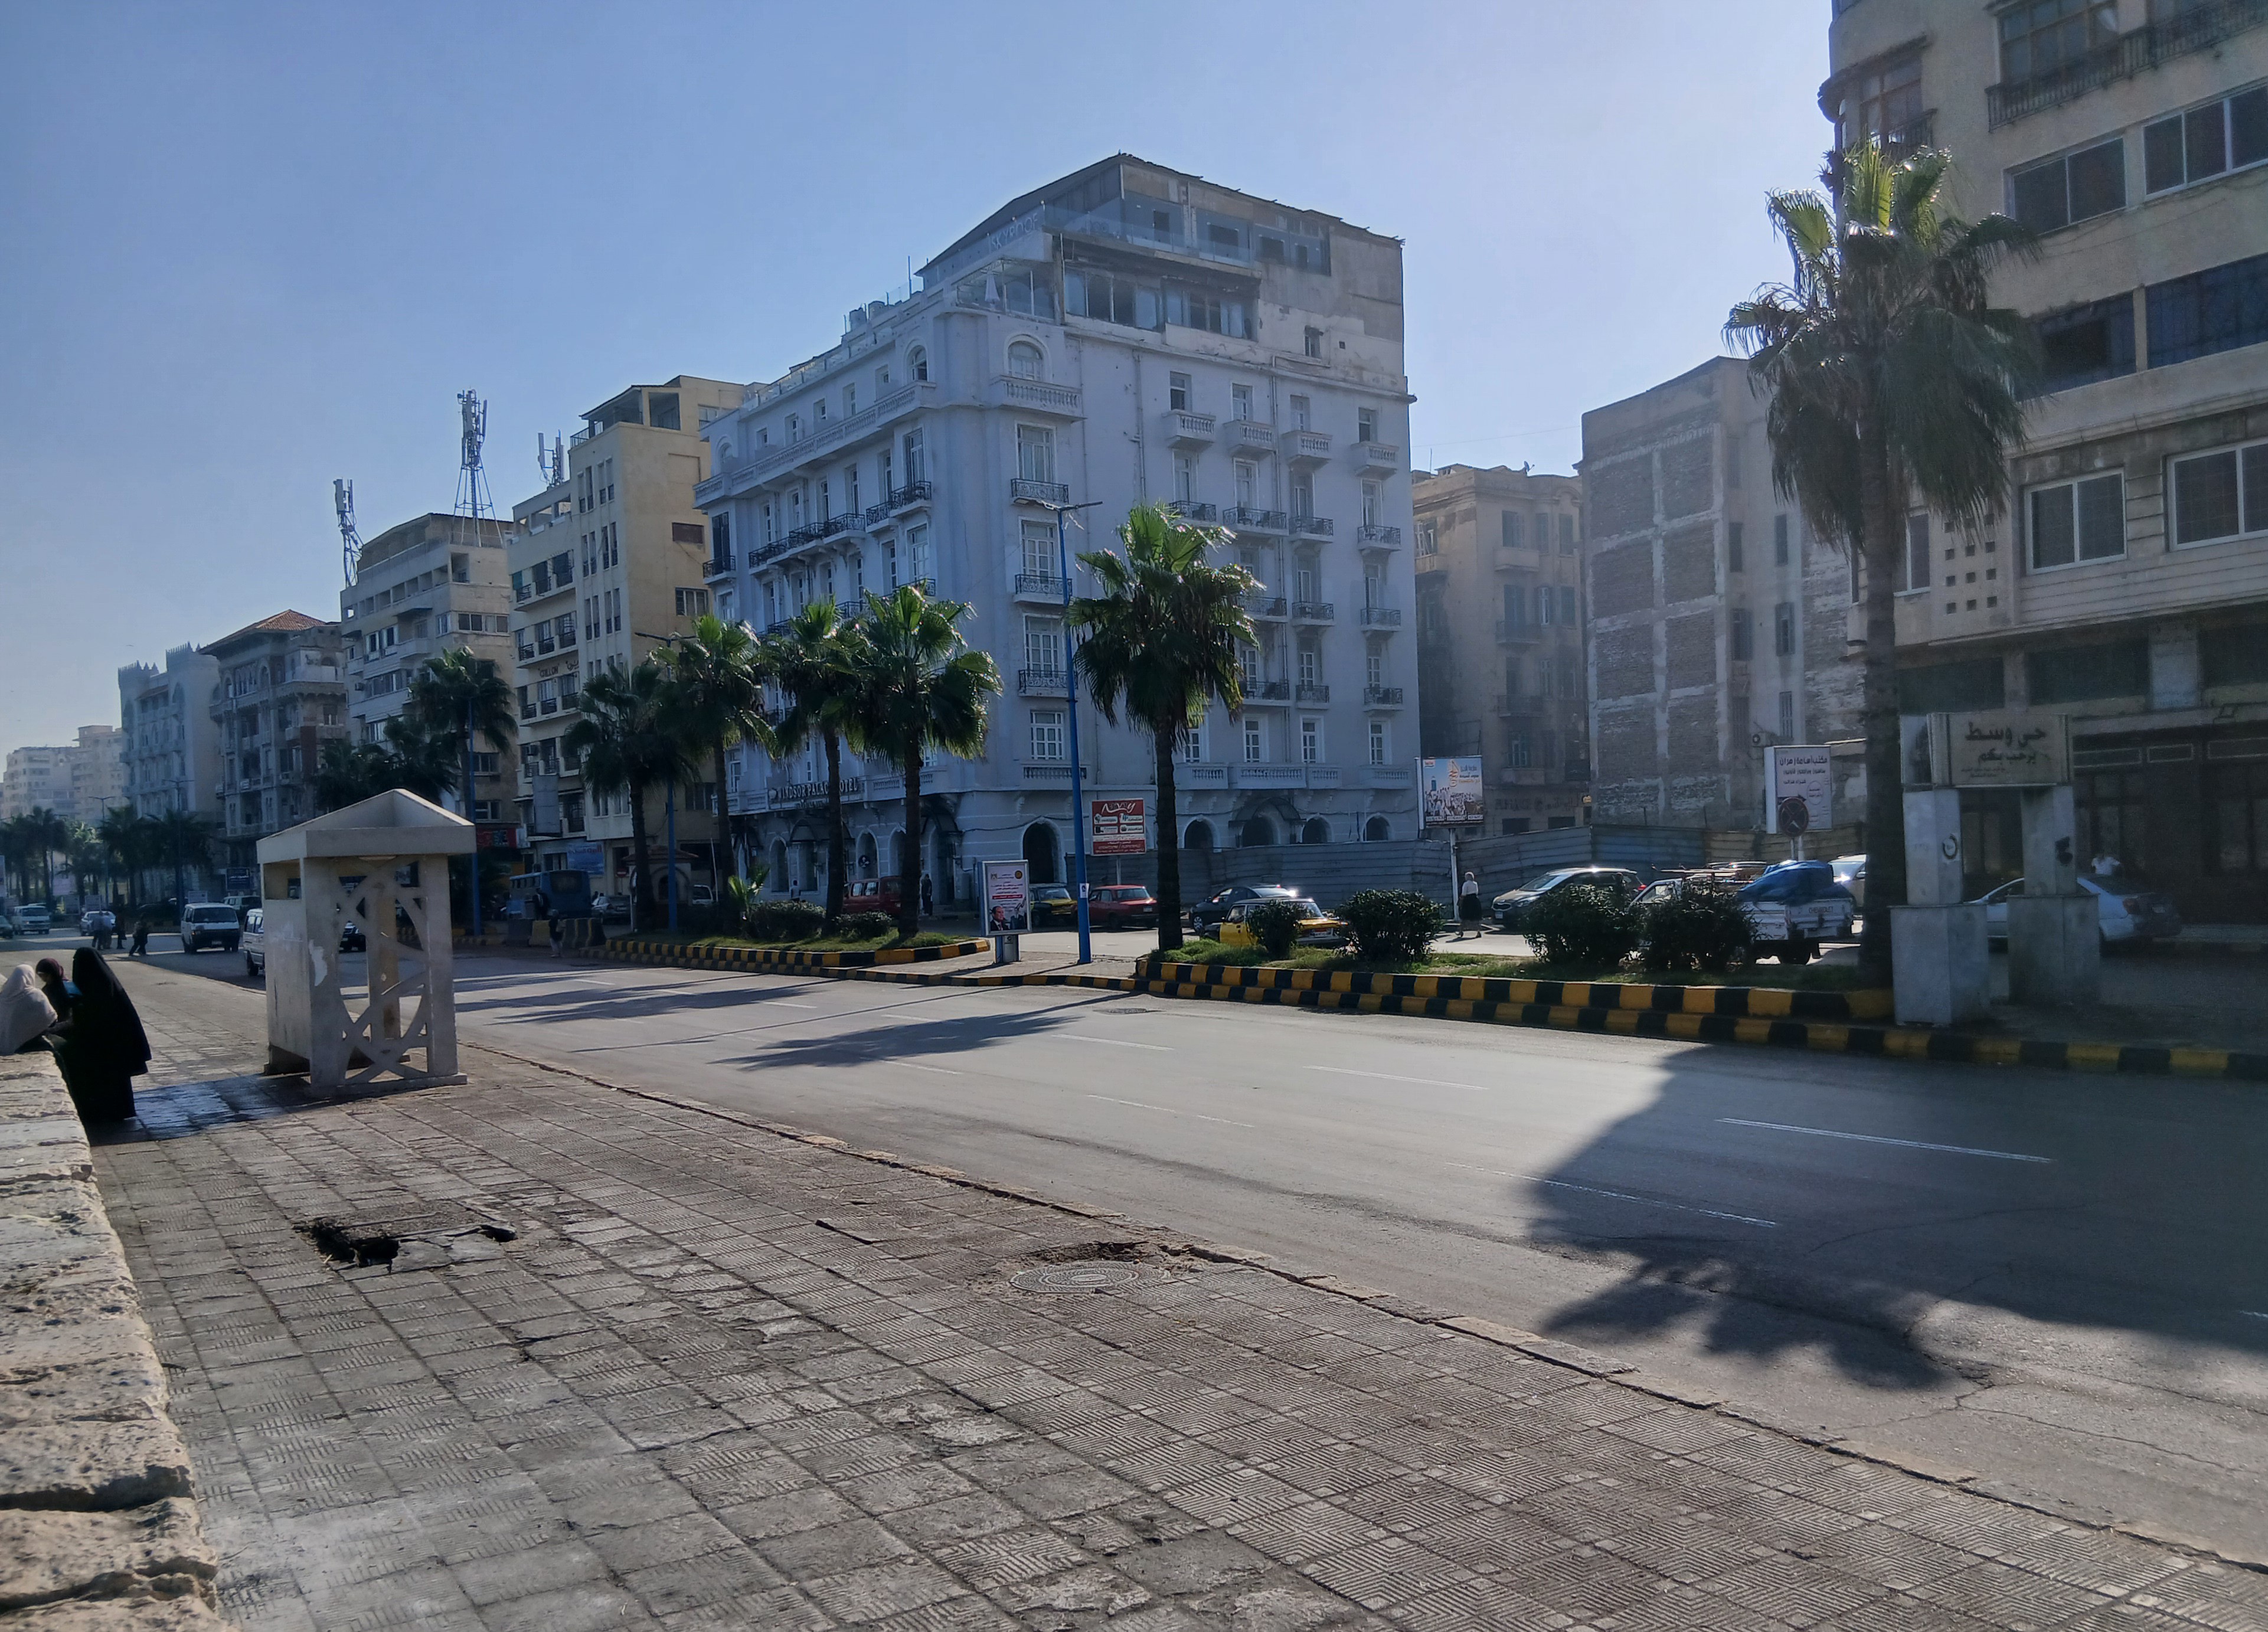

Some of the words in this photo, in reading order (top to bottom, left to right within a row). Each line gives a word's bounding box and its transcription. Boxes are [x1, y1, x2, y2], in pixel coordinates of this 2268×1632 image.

[1965, 721, 2012, 747] وسط
[1813, 755, 1828, 766] مكتب
[1978, 748, 2002, 766] بكم
[808, 781, 829, 796] PALAC
[839, 777, 858, 792] OTEL
